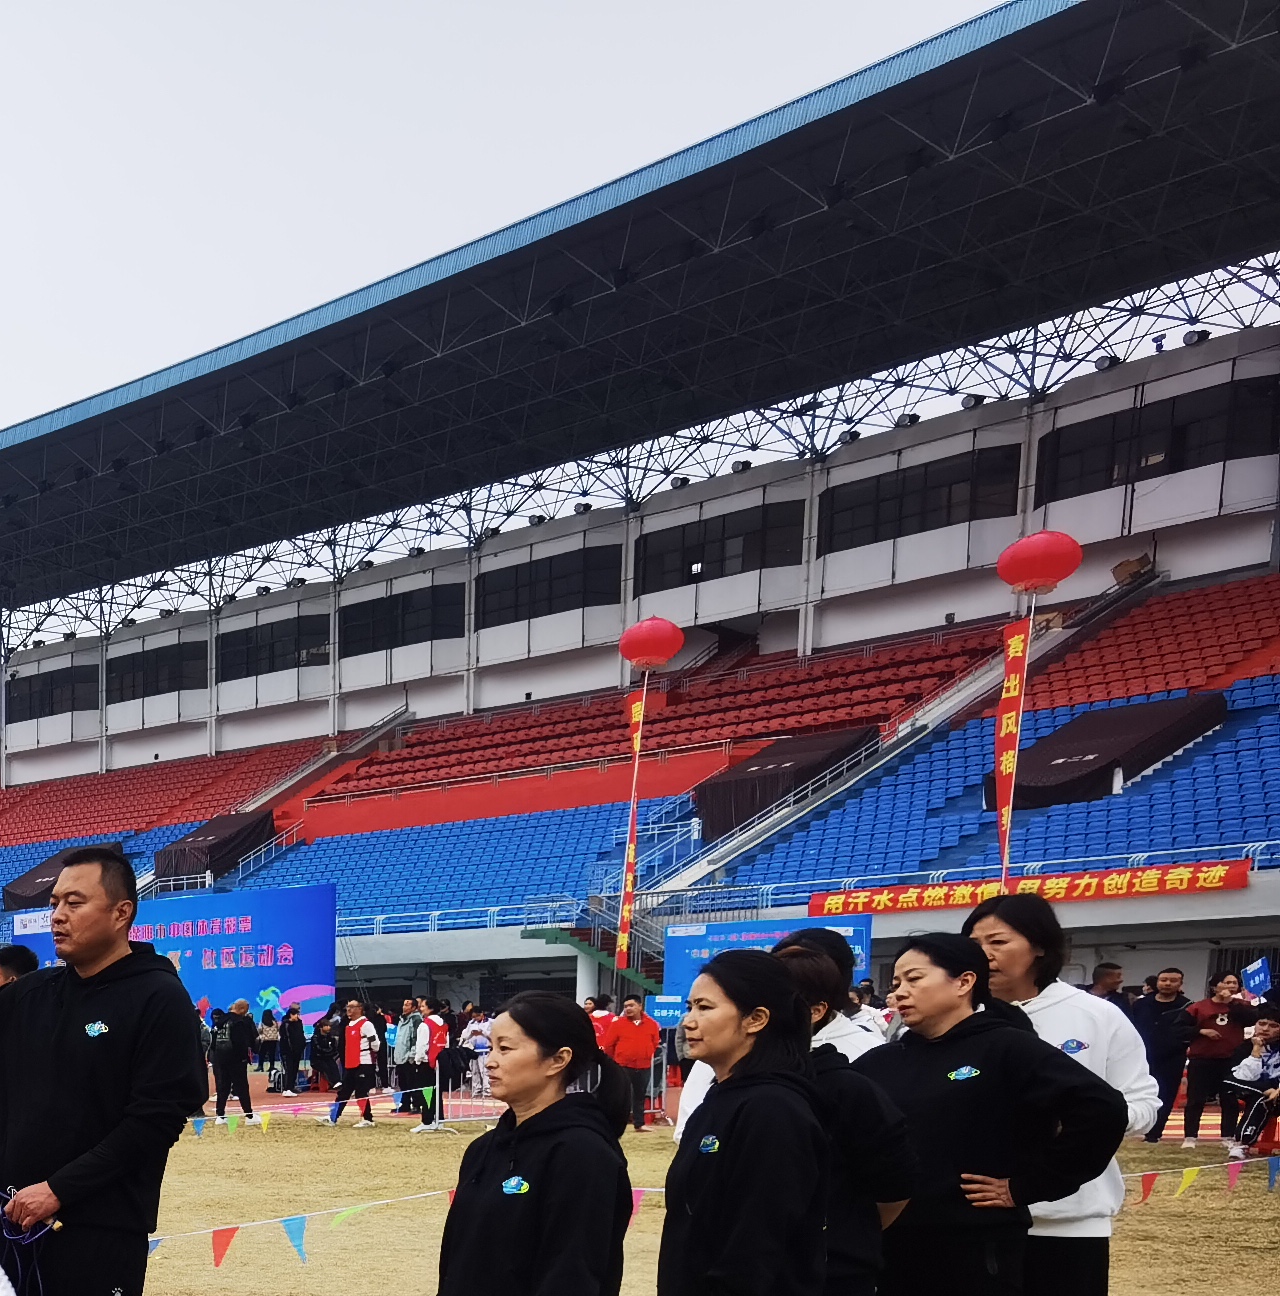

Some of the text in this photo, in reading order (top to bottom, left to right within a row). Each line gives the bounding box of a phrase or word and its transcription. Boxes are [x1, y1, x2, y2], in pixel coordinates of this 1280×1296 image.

[823, 863, 1229, 914] 用汗水点燃激情 用努力创造奇迹
